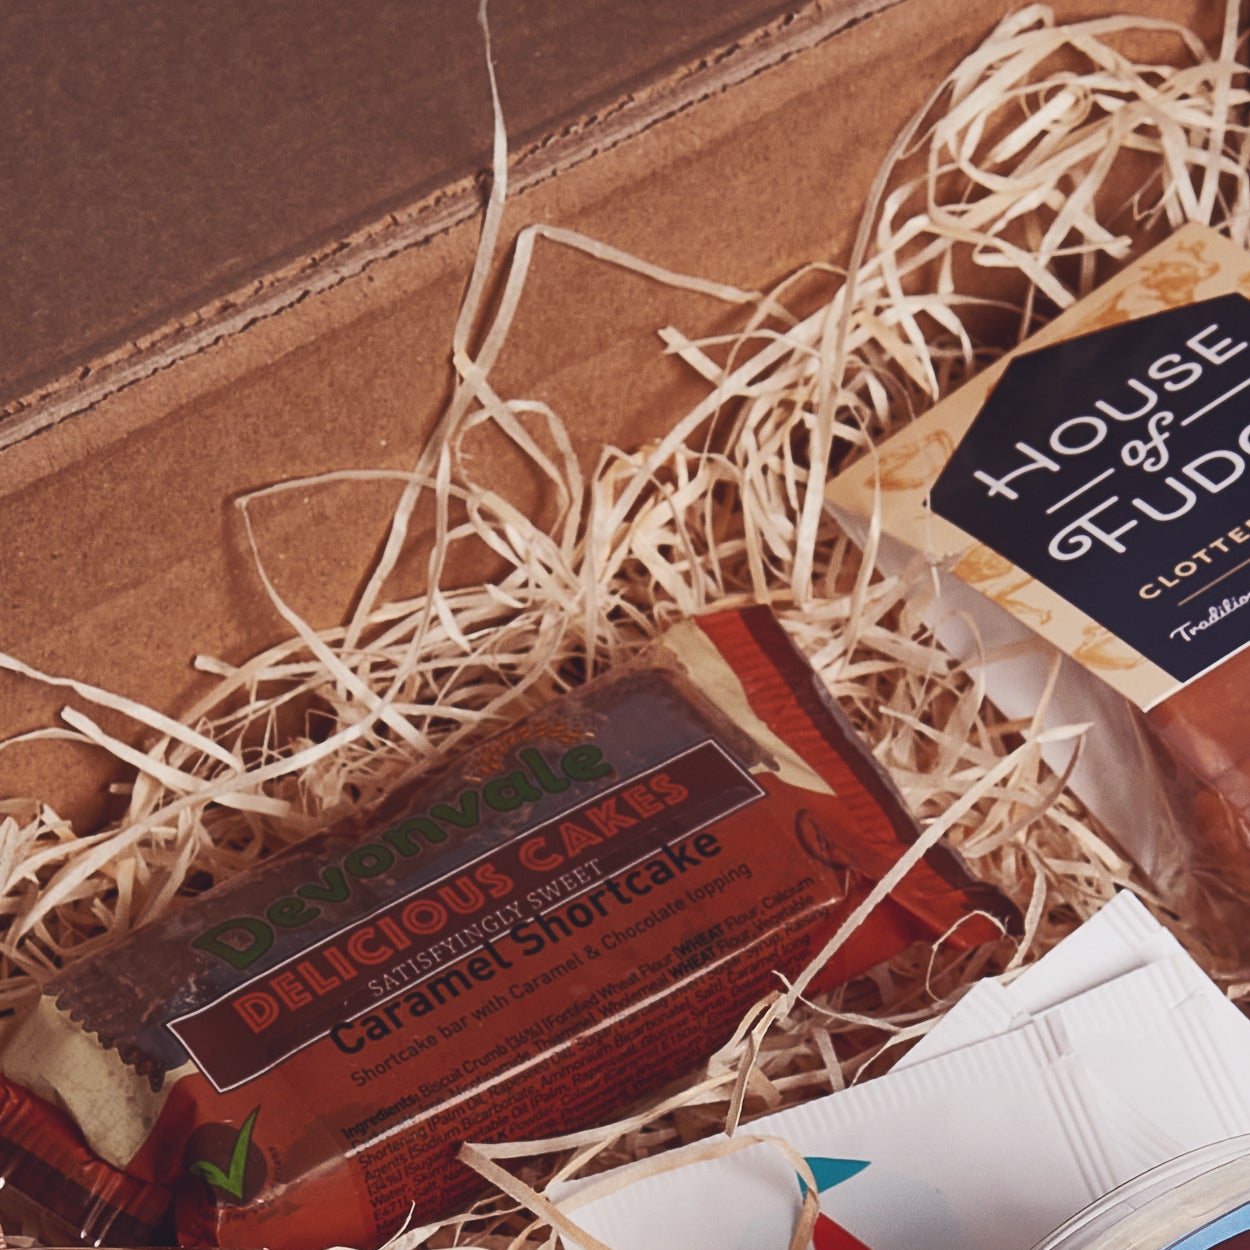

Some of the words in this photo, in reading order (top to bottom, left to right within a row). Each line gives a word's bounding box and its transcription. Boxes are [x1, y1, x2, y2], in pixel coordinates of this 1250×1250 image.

[974, 323, 1249, 500] HOUSE
[1121, 410, 1174, 472] of
[192, 742, 614, 971] Devonvale
[233, 858, 514, 1034] DELICIOUS
[517, 773, 689, 874] CAKES
[329, 939, 512, 1055] Caramel
[509, 831, 722, 957] Shortcake
[366, 901, 525, 998] SATISFYINGLY
[526, 858, 601, 911] SWEET
[350, 1035, 437, 1086] Shortcake
[436, 1015, 467, 1039] bar
[470, 995, 509, 1020] with
[508, 952, 583, 999] Caramel
[583, 944, 601, 959] &
[600, 899, 686, 949] Chocolate
[684, 863, 752, 909] topping
